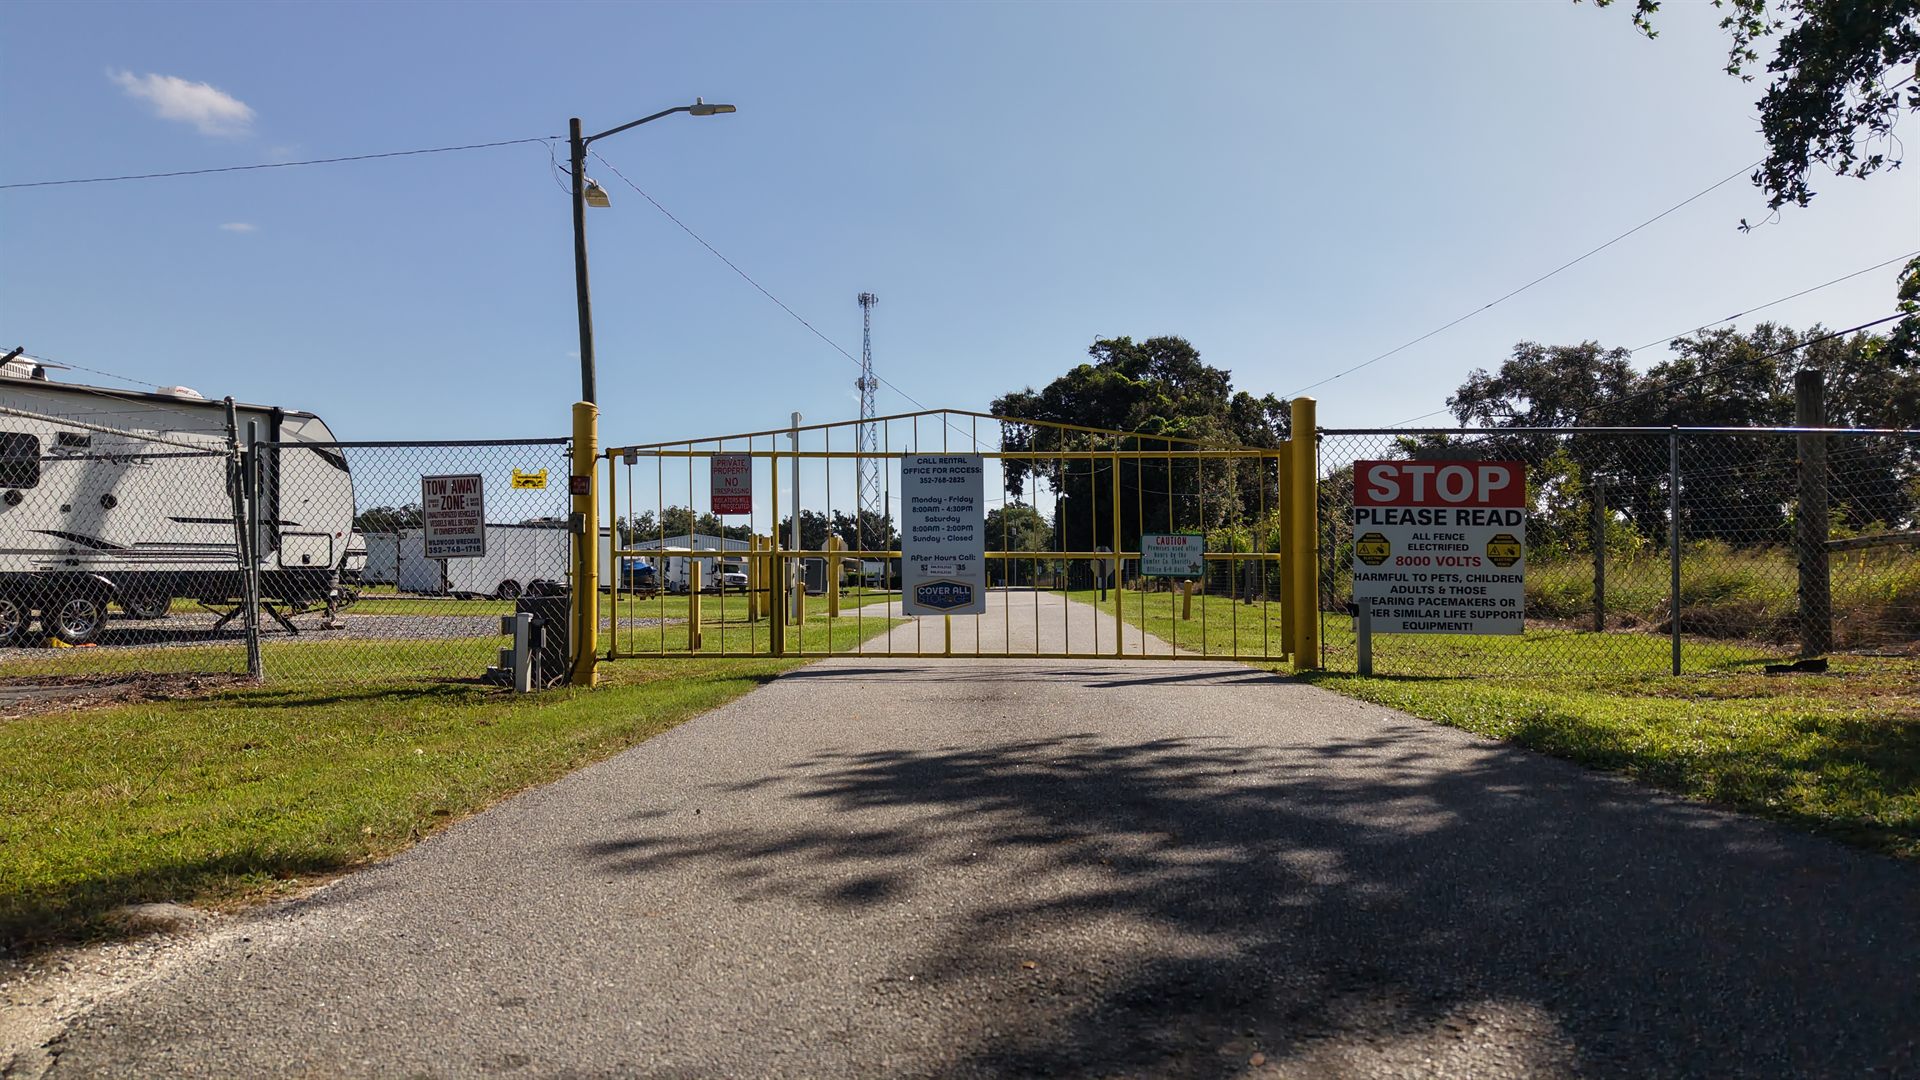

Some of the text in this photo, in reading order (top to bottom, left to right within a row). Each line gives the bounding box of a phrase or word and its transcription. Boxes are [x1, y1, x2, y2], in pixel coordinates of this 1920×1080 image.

[725, 478, 738, 486] NO
[1368, 464, 1510, 503] STOP
[426, 479, 478, 495] TOW AWAY
[441, 496, 465, 510] ZONE
[912, 496, 942, 504] Monday
[949, 496, 974, 504] Friday
[1355, 509, 1522, 527] PLEASE READ
[913, 535, 940, 543] Sunday
[1156, 537, 1187, 545] CAUTION
[1396, 556, 1481, 567] 8000 VOLTS
[1354, 573, 1522, 584] HARMFUL TO PETS, CHILDREN
[918, 586, 970, 595] COVER ALL
[1390, 586, 1486, 595] ADULTS & THOSE
[1418, 598, 1496, 607] PACEMAKERS
[1500, 599, 1515, 607] OR
[1393, 609, 1440, 618] SIMILAR
[1444, 610, 1466, 618] LIFE
[1470, 610, 1523, 619] SUPPORT
[1402, 622, 1473, 631] EQUIPMENT!
